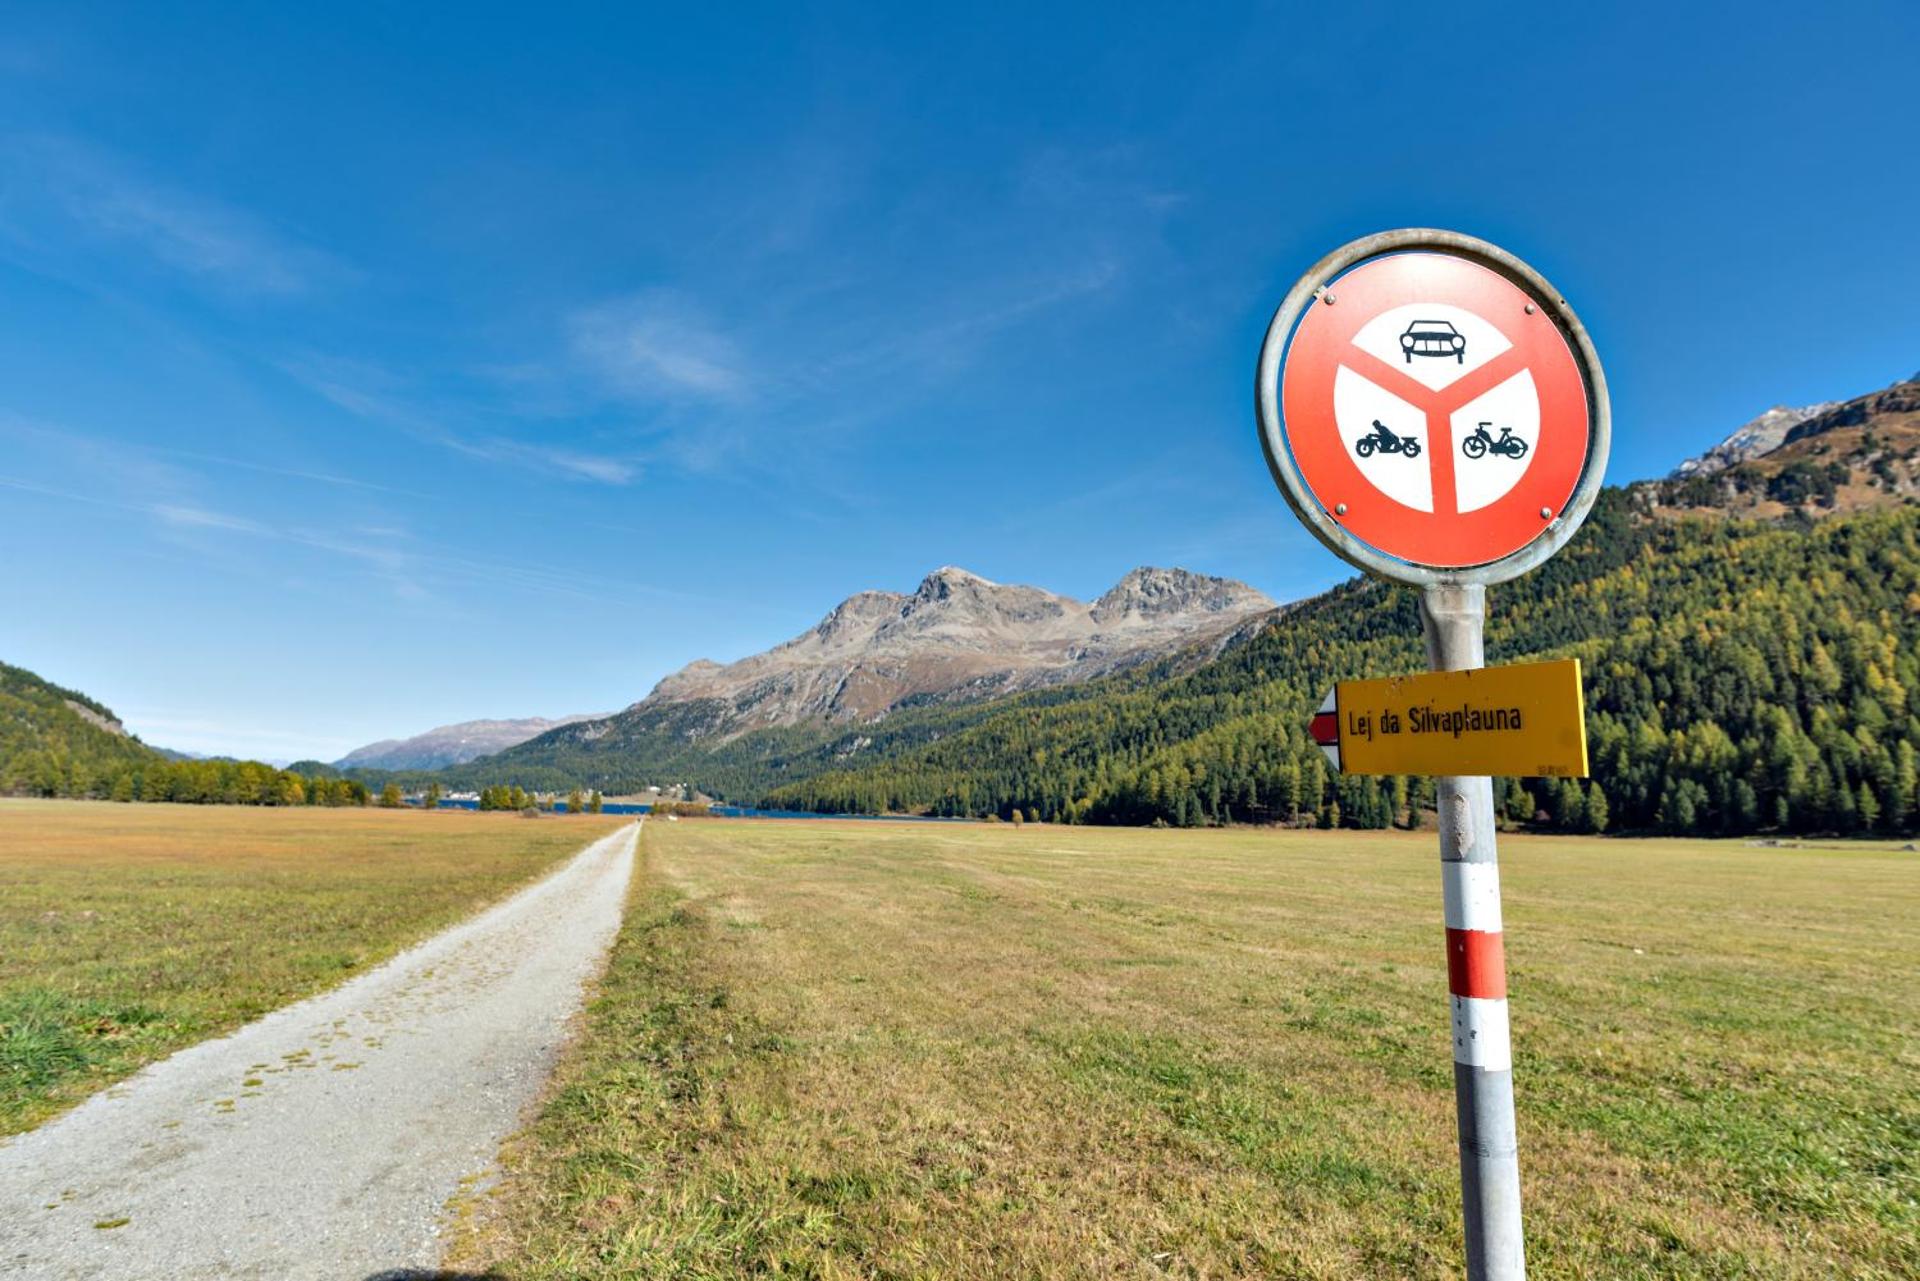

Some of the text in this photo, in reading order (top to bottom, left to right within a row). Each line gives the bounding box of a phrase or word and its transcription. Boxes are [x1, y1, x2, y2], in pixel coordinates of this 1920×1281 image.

[1349, 704, 1522, 742] Lej da Silvaplauna
